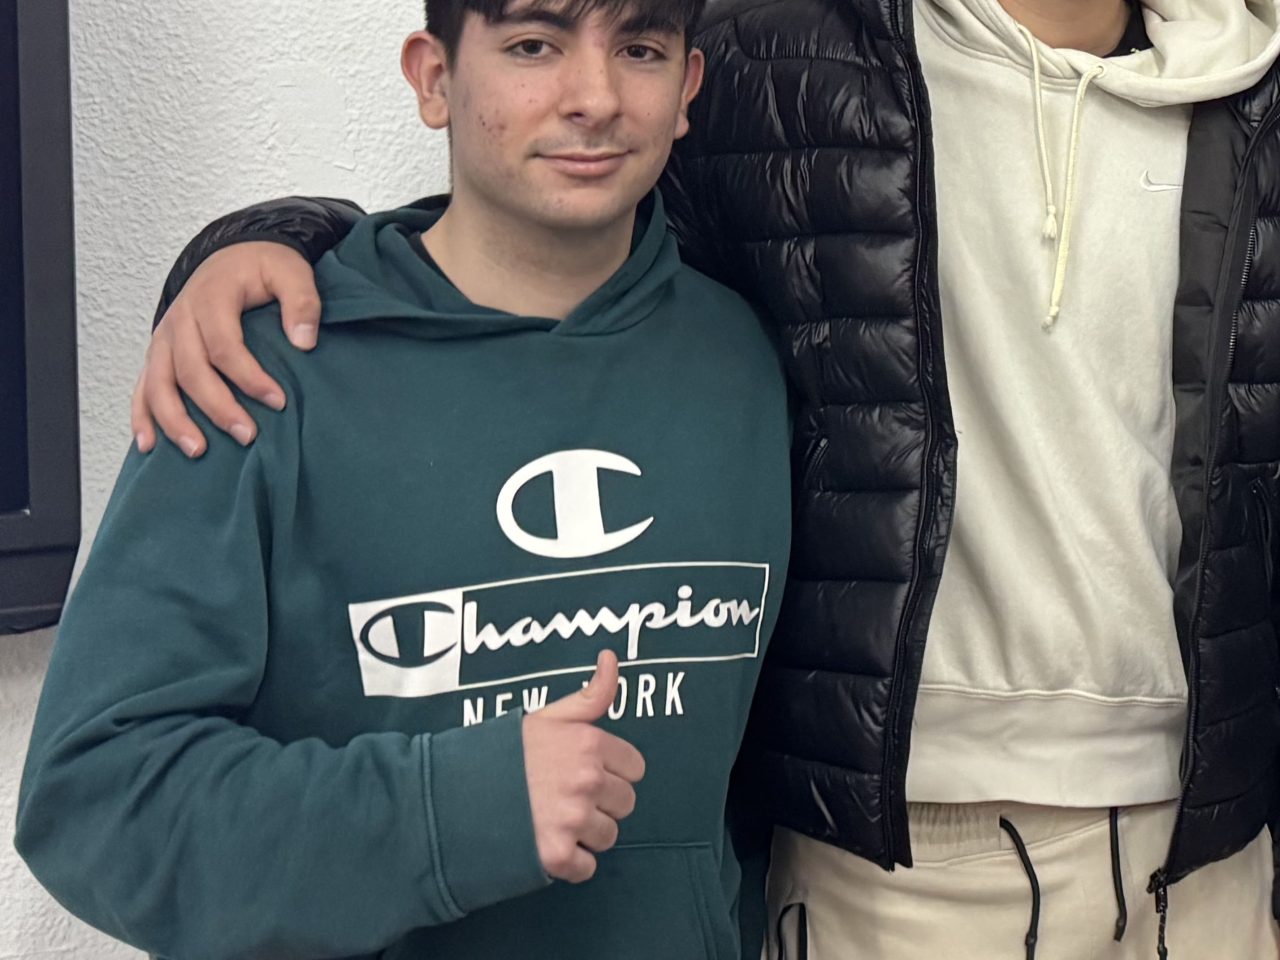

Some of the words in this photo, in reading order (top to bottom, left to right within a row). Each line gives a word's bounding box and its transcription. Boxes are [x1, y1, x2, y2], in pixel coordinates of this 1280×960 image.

[359, 584, 761, 669] Champion
[463, 685, 549, 728] NEW
[581, 671, 686, 721] ORK
